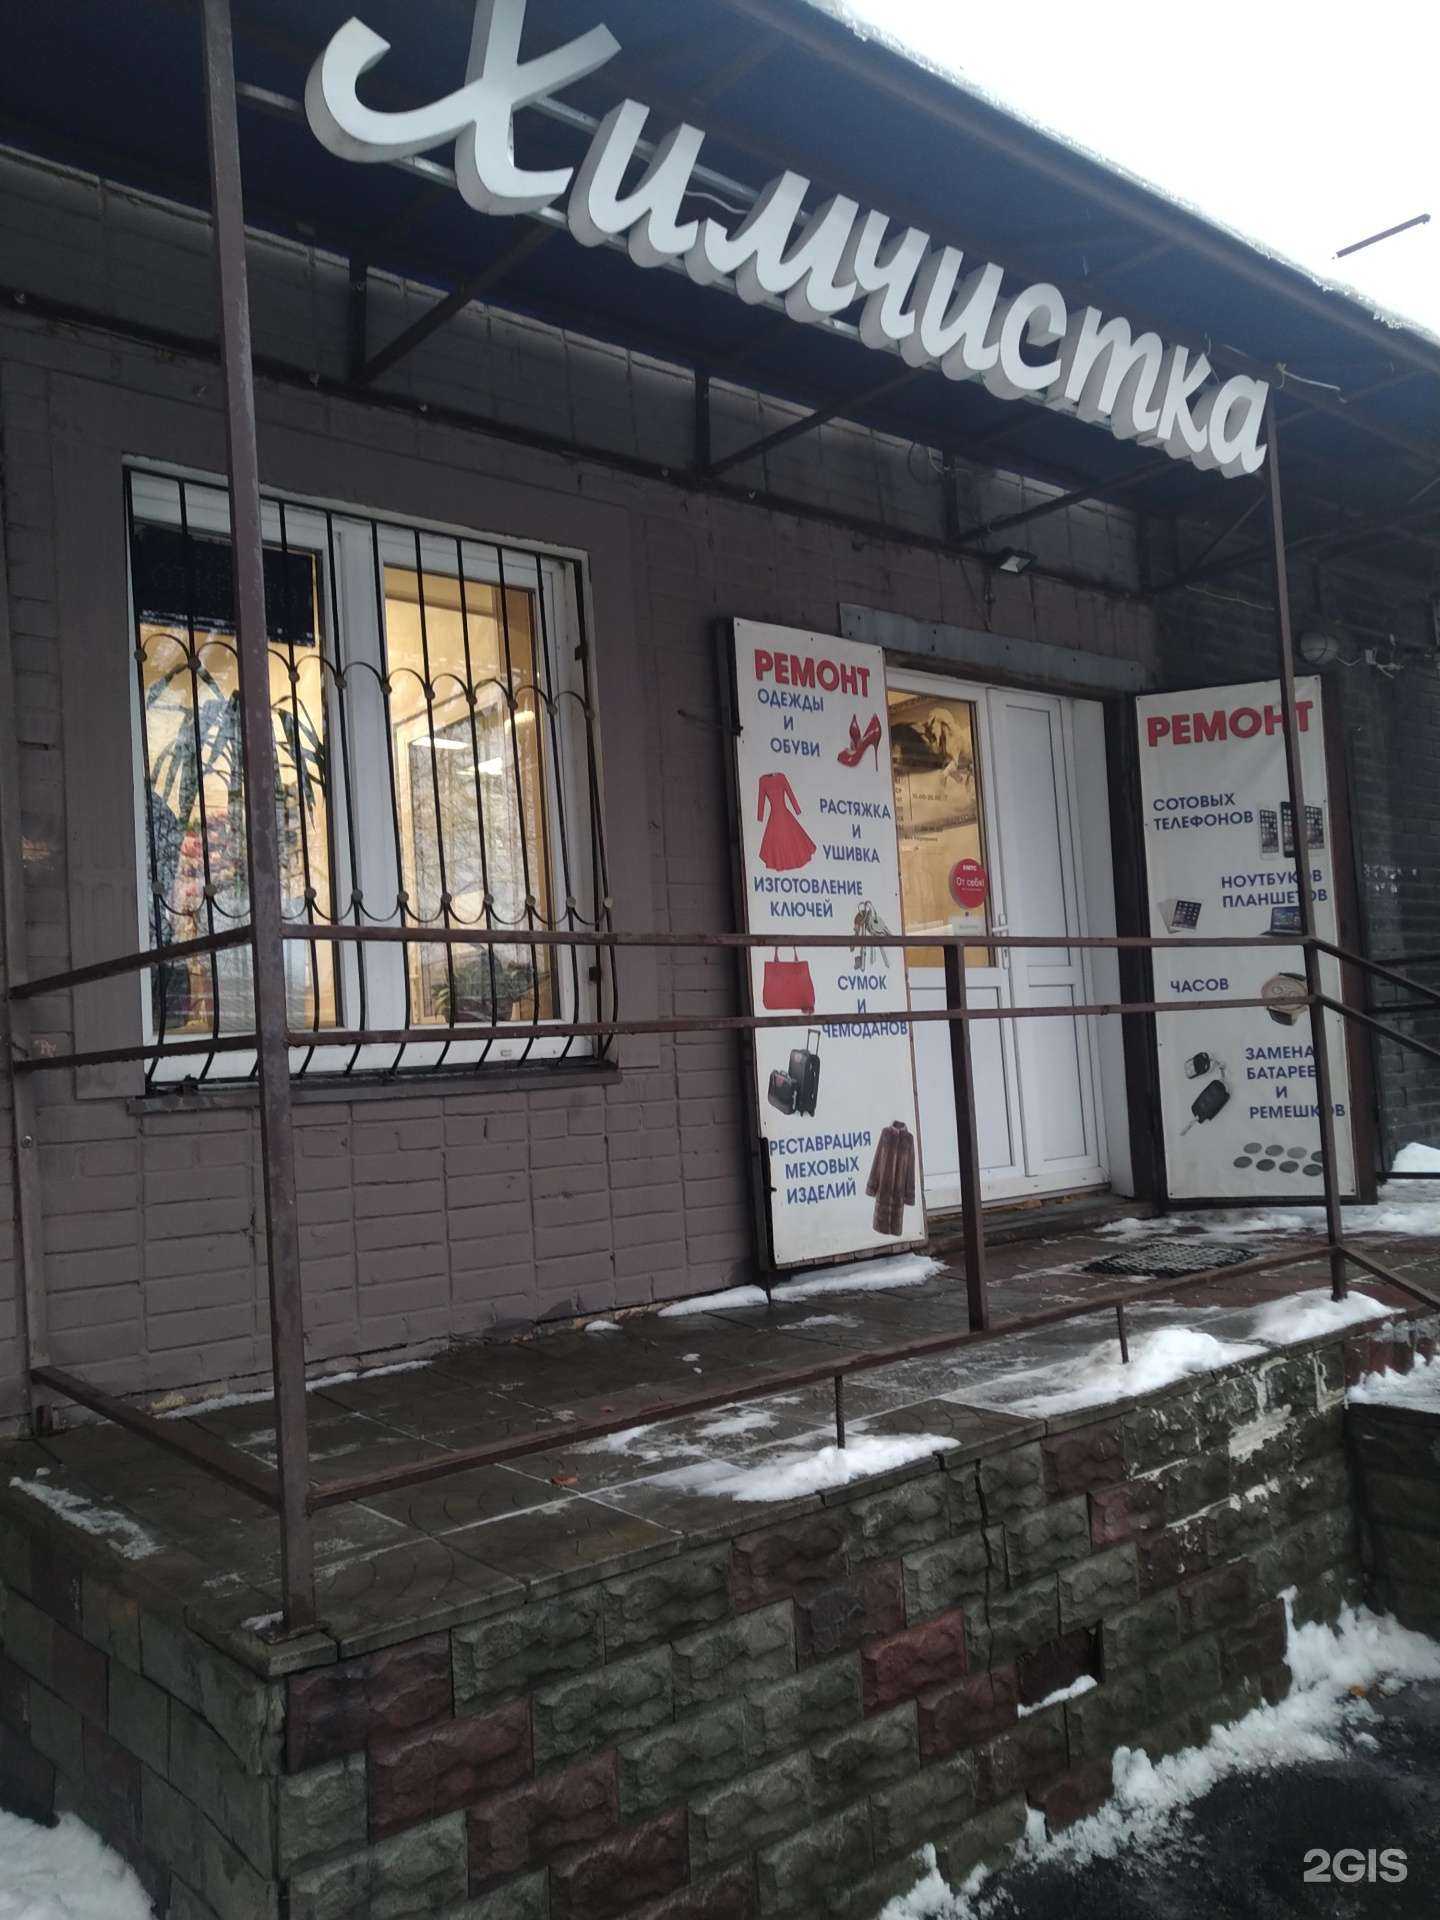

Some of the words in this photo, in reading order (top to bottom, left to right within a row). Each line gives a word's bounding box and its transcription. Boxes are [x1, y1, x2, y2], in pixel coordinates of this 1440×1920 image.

[304, 0, 1270, 478] Химчистка
[754, 648, 871, 697] РЕМОНТ
[757, 687, 824, 712] ОДЕЖДЫ
[784, 715, 794, 731] И
[1146, 700, 1314, 747] РЕМОНТ
[770, 737, 821, 757] ОБУВИ
[819, 798, 891, 820] РАСТЯЖКА
[1153, 792, 1236, 812] СОТОВЫХ
[1154, 810, 1253, 831] ТЕЛЕФОНОВ
[852, 823, 861, 839] И
[822, 844, 880, 864] УШИВКА
[754, 876, 863, 896] ИЗГОТОВЛЕНИЕ
[1221, 869, 1322, 889] НОУТБУКВ
[770, 896, 833, 918] КЛЮЧЕЙ
[837, 975, 887, 991] СУМОК
[1170, 978, 1229, 993] ЧАСОВ
[857, 999, 866, 1014] И
[822, 1020, 908, 1039] ЧЕМОДАНОВ
[1245, 1045, 1315, 1060] ЗАМЕНА
[1247, 1065, 1318, 1080] БАТАРЕЕ
[1275, 1086, 1288, 1099] И
[1249, 1103, 1346, 1119] РЕМЕШКВ
[769, 1130, 872, 1156] РЕСТАВРАЦИЯ
[785, 1156, 860, 1180] МЕХОВЫХ
[786, 1177, 857, 1205] ИЗДЕЛИЙ
